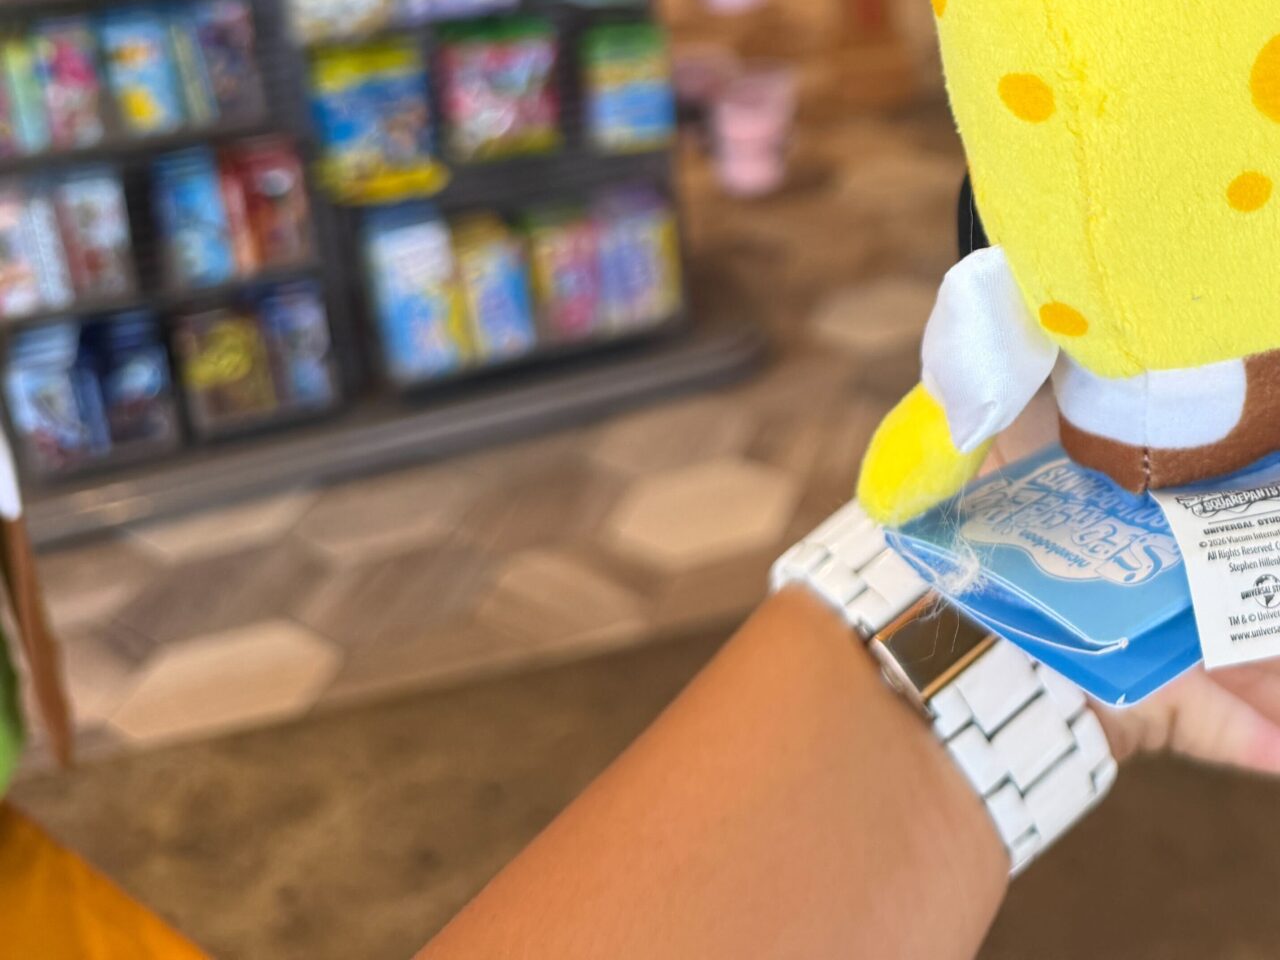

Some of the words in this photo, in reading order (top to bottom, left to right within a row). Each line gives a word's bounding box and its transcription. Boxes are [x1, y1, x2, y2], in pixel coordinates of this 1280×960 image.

[1205, 486, 1279, 512] SQUAREPANTS
[1203, 521, 1254, 535] UNIVERSAL
[1227, 533, 1253, 544] Viacom
[1208, 551, 1218, 561] All
[1218, 548, 1241, 561] Rights
[1241, 542, 1275, 556] Reserved.
[1229, 560, 1259, 574] Stephen
[1240, 586, 1271, 600] UNIVERSAL
[1228, 613, 1240, 626] TM
[1241, 613, 1247, 624] &
